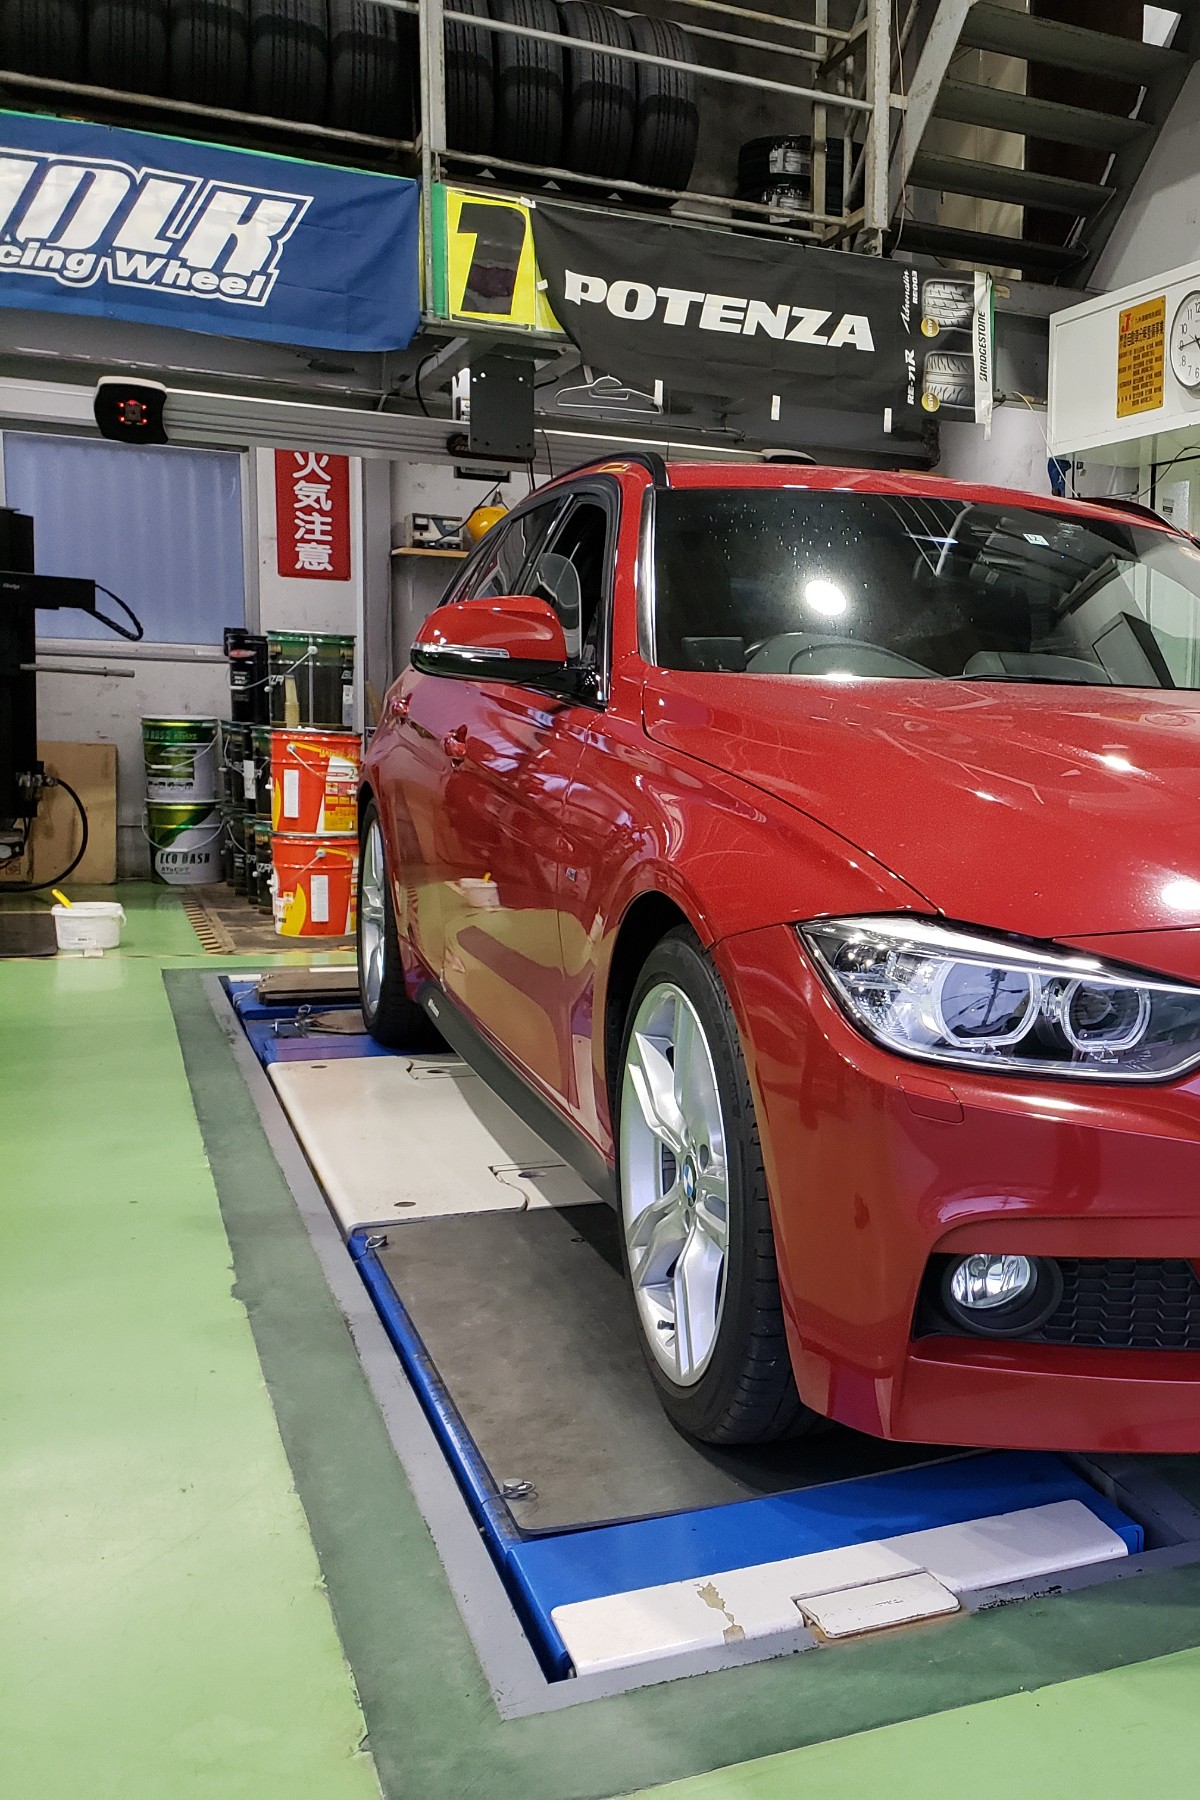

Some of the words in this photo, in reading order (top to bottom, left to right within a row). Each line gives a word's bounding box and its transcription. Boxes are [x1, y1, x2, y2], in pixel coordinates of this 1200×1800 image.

[115, 250, 267, 298] Wheel
[564, 269, 876, 352] POTENZA
[978, 310, 988, 382] BRIDGESTONE
[904, 349, 917, 406] RE-71R
[292, 451, 334, 571] 火気注意
